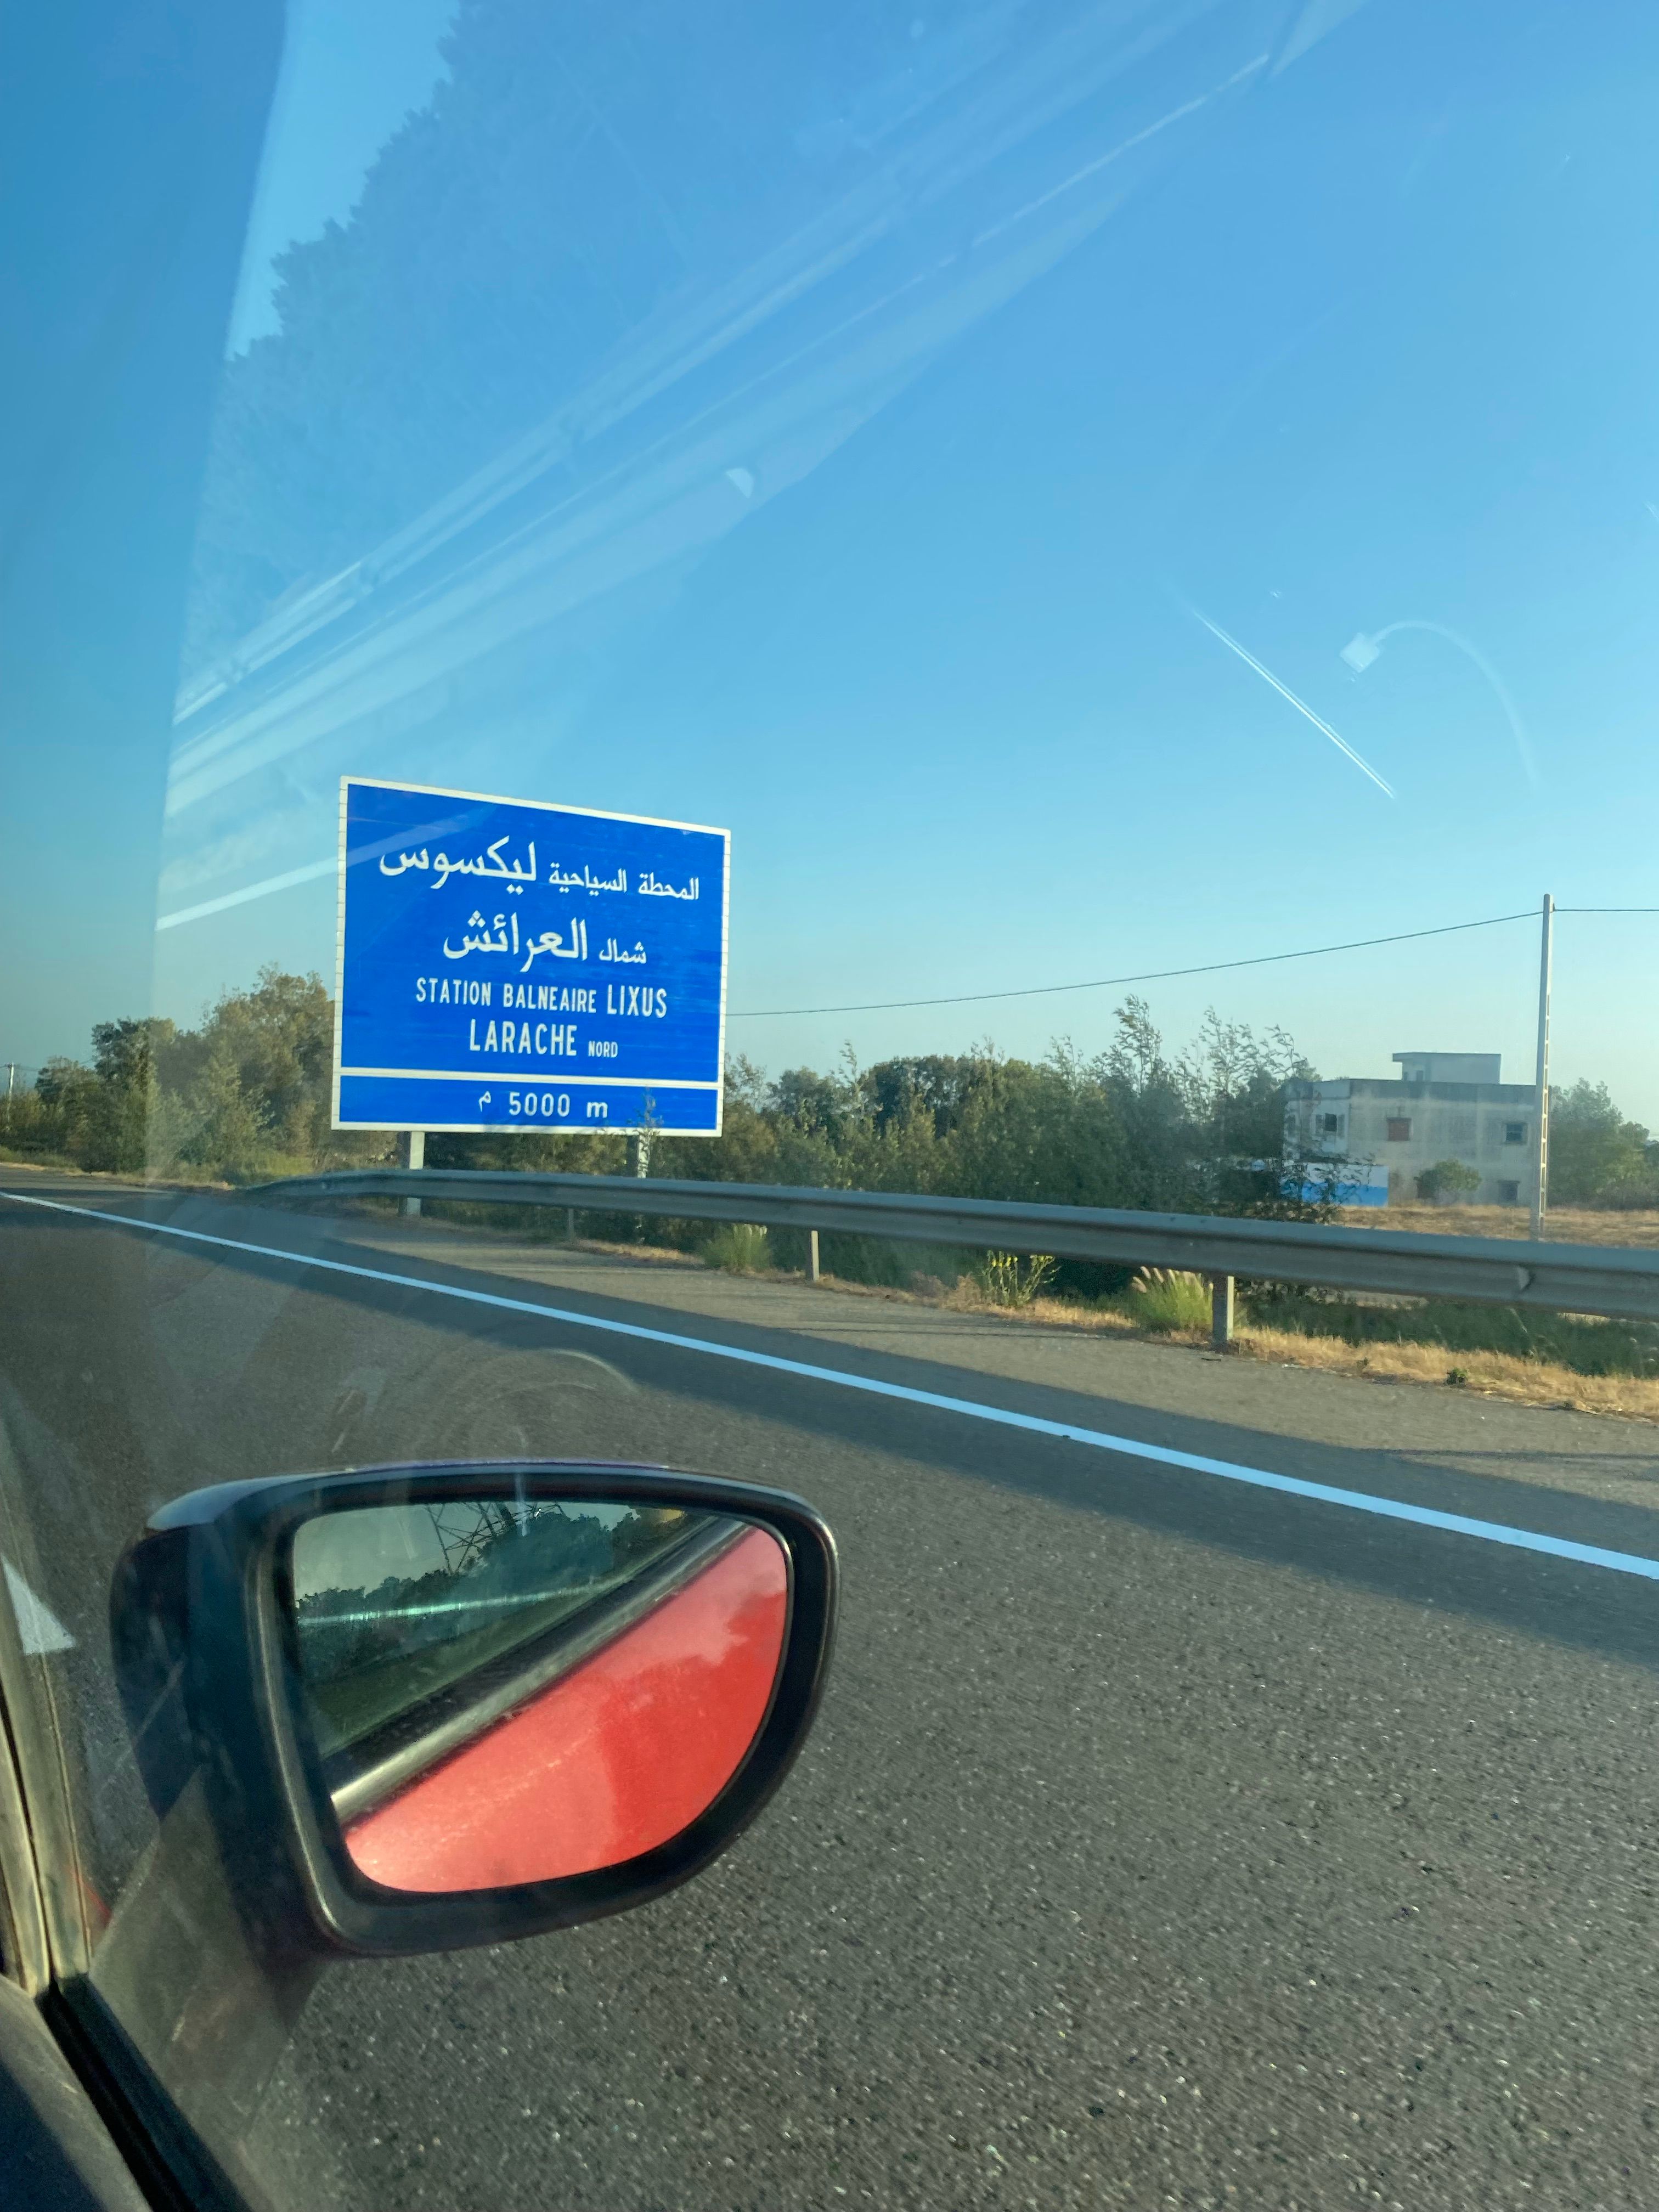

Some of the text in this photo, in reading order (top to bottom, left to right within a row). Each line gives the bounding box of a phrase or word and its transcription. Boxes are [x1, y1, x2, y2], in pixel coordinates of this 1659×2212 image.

[380, 836, 699, 900] المحطة السياحية ليكسوس
[443, 910, 646, 972] شمال العرائش
[416, 978, 667, 1018] STATION BALNEAIRE LIXUS
[470, 1019, 618, 1058] LARACHE NORD
[509, 1092, 570, 1116] 5000
[587, 1102, 608, 1118] m
